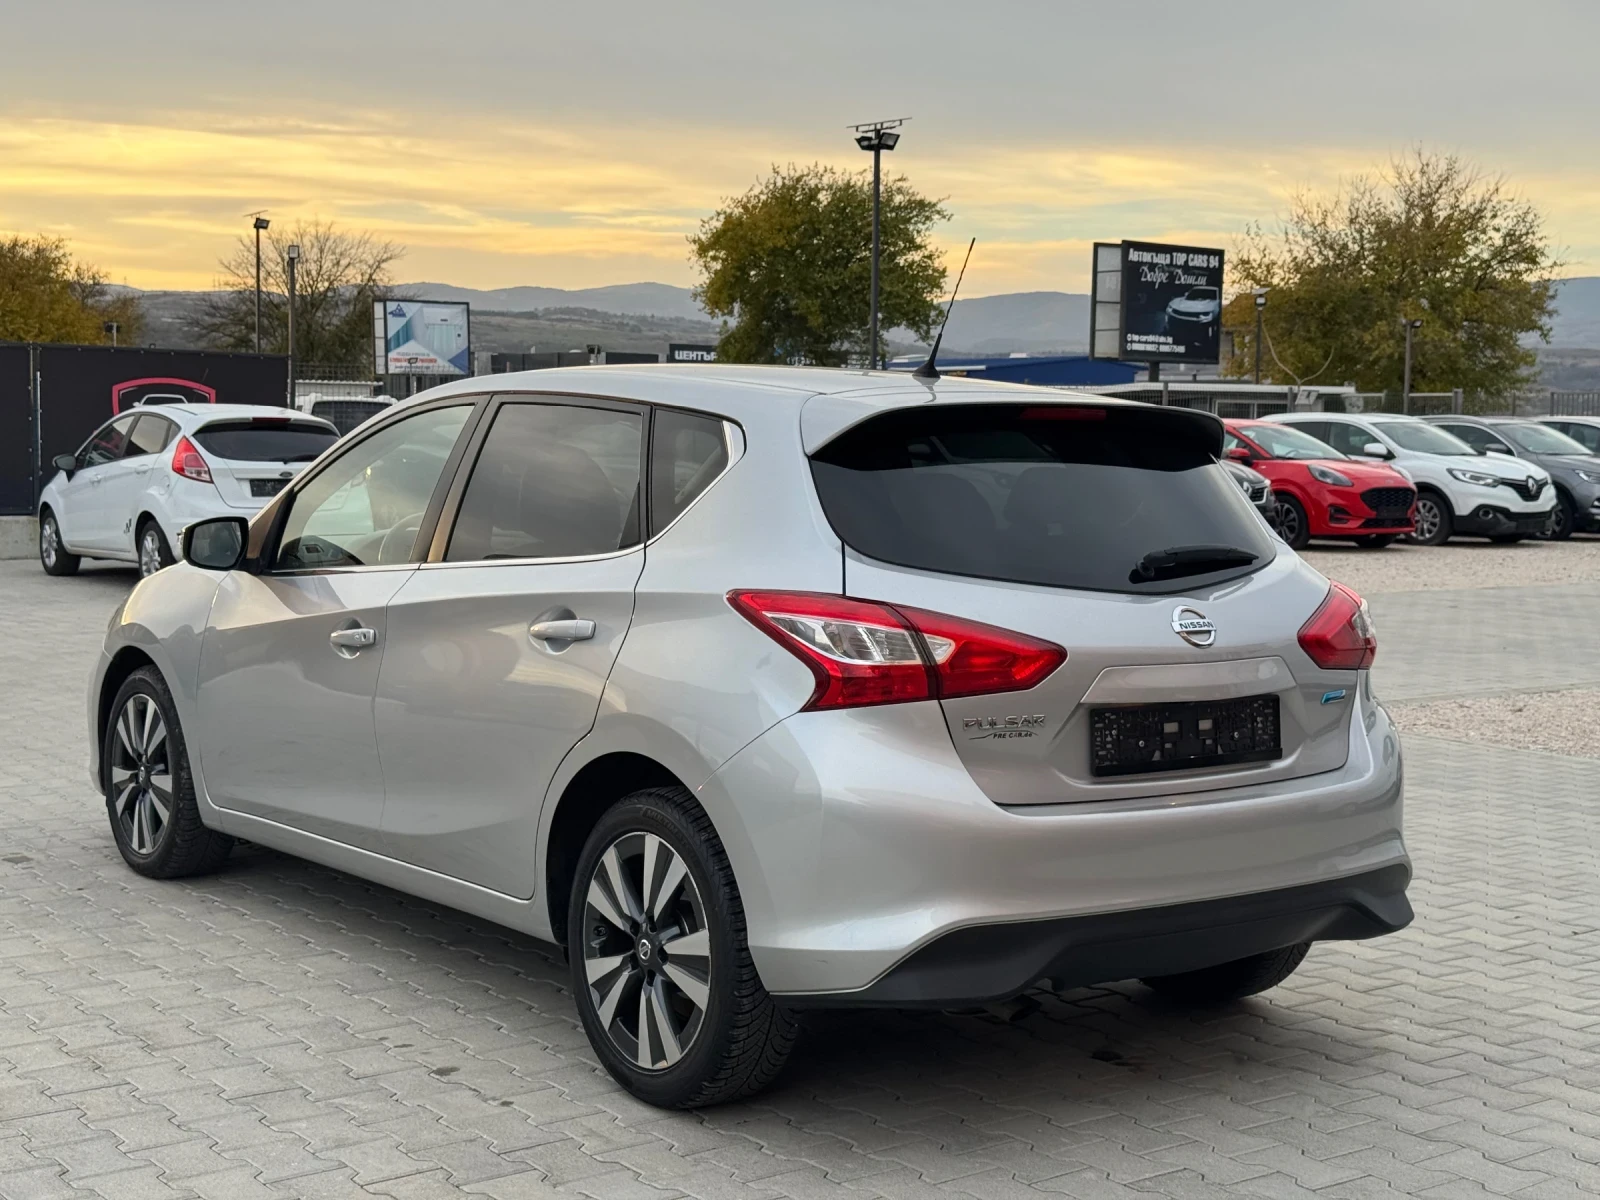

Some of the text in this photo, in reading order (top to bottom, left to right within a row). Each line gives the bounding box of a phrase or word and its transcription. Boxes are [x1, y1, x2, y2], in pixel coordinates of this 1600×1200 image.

[1172, 252, 1187, 266] TOP
[1188, 254, 1208, 268] CARS
[1209, 255, 1219, 269] 94
[1179, 621, 1214, 630] NISSAN
[963, 714, 1046, 731] PULSAR
